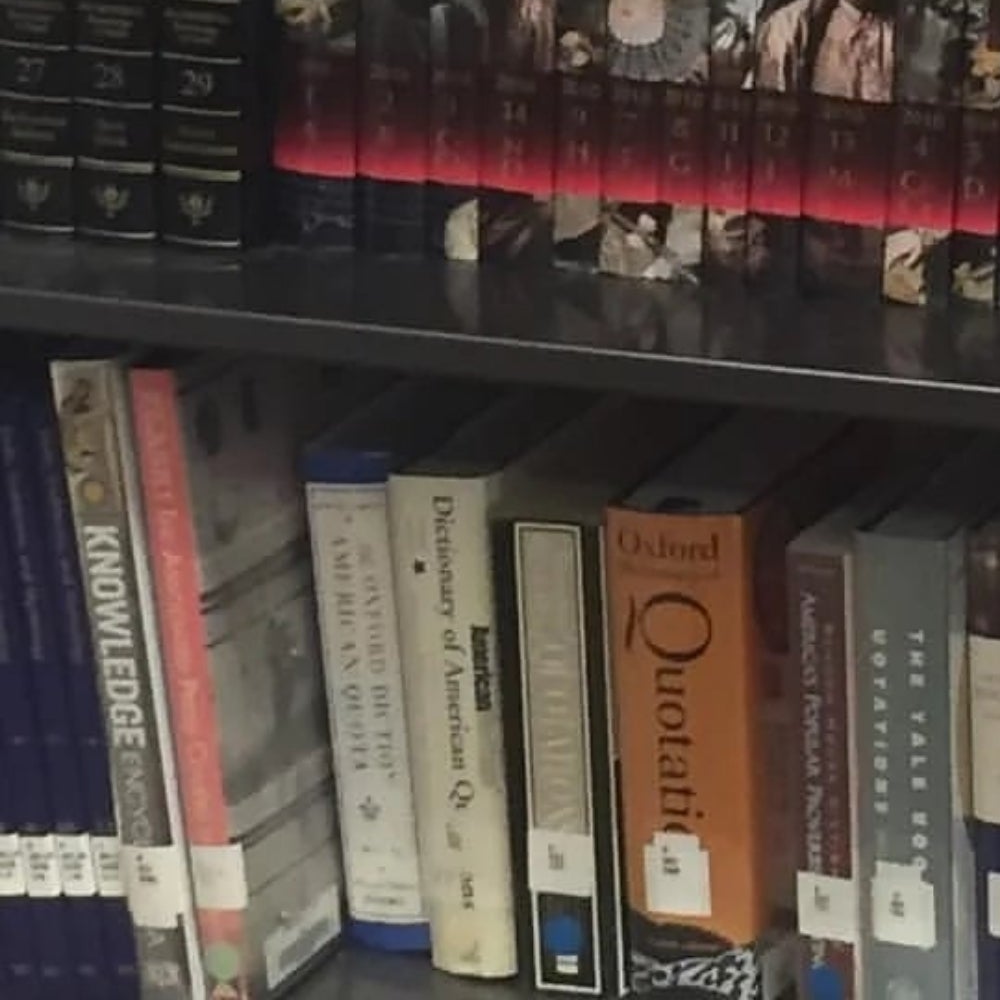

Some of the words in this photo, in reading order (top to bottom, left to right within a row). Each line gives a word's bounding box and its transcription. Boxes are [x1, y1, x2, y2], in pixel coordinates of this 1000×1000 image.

[178, 68, 214, 97] 29
[432, 495, 456, 618] Dictionary
[618, 528, 721, 562] Oxford
[83, 524, 148, 749] KNOWLEDGE
[443, 629, 468, 657] of
[907, 628, 927, 689] THE
[443, 659, 471, 770] American
[625, 591, 712, 833] Quotati
[909, 710, 929, 791] YALE
[911, 811, 929, 872] BOO
